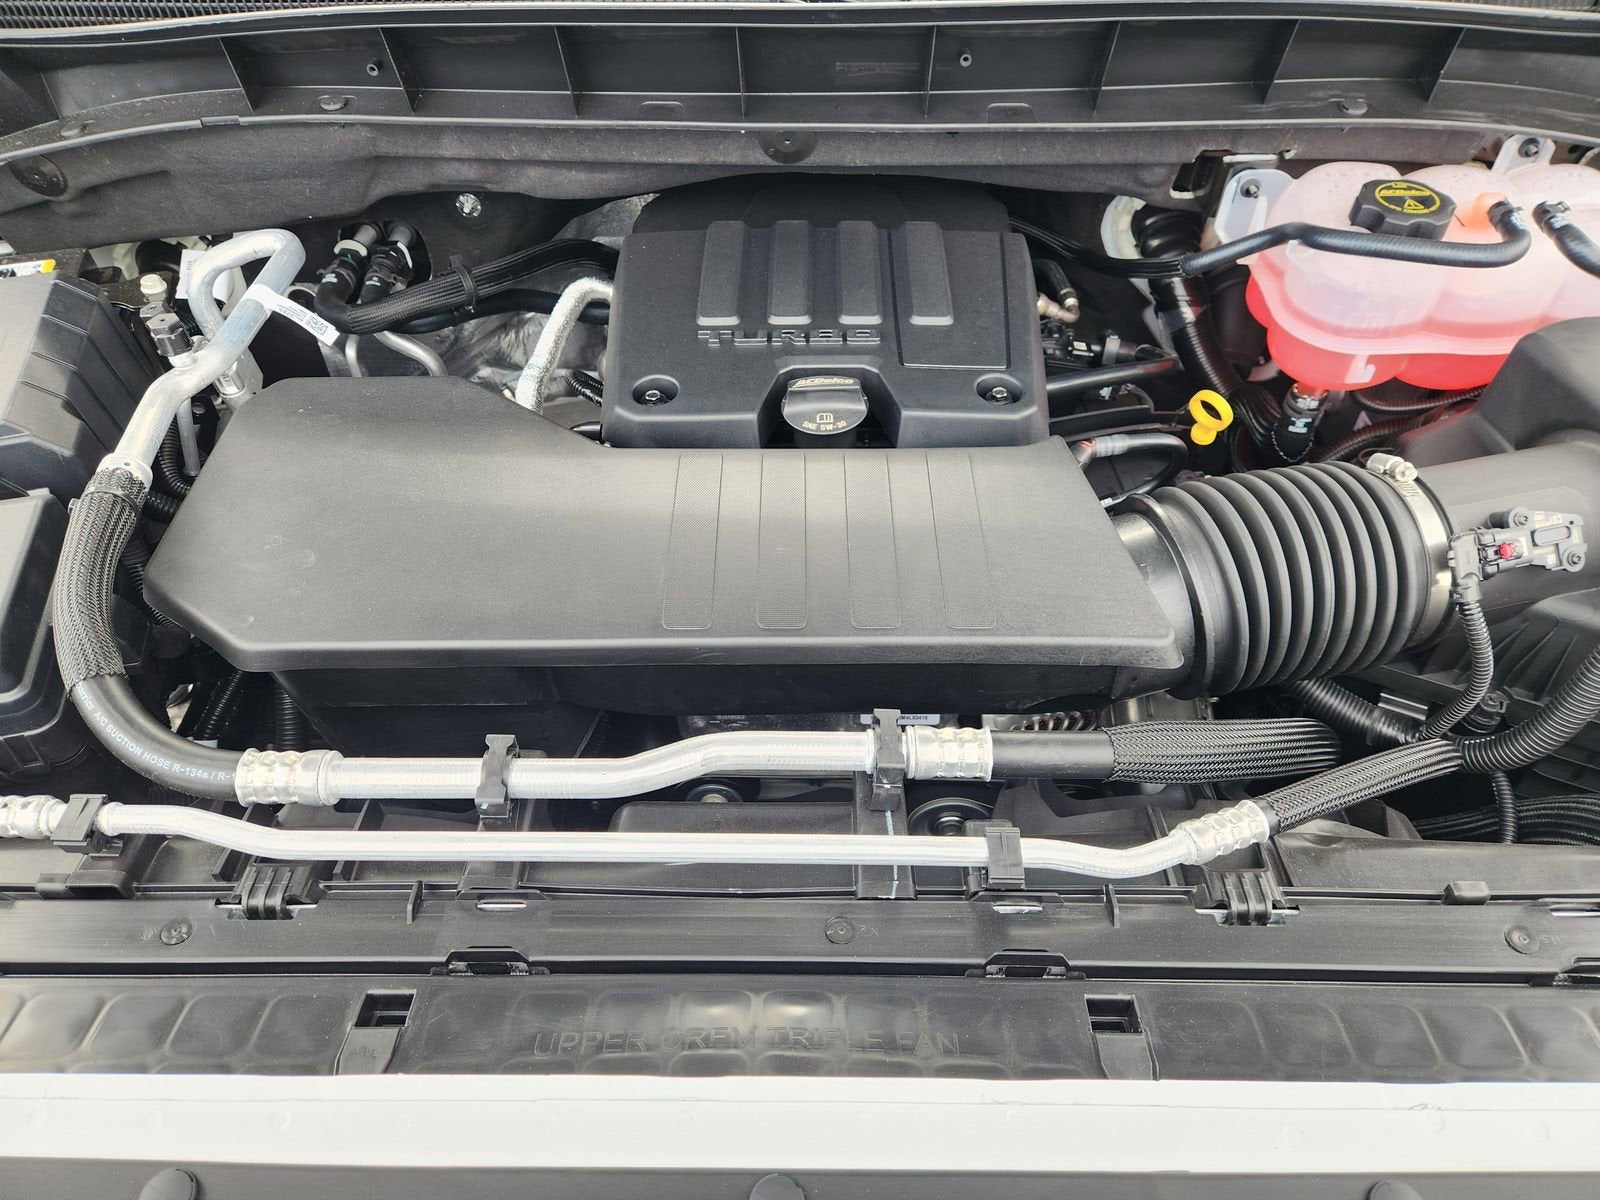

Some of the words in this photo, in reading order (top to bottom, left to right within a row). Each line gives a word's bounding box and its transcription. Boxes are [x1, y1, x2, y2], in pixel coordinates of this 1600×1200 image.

[697, 330, 881, 347] TURBO
[792, 377, 854, 388] ACDelco
[802, 420, 817, 430] SAE
[820, 420, 847, 431] 5W-30
[94, 711, 108, 727] A/C
[106, 723, 144, 757] SUCTION
[142, 751, 172, 770] HOSE
[172, 763, 209, 779] R-134a
[533, 1030, 648, 1058] UPPER
[895, 1030, 961, 1058] FAN
